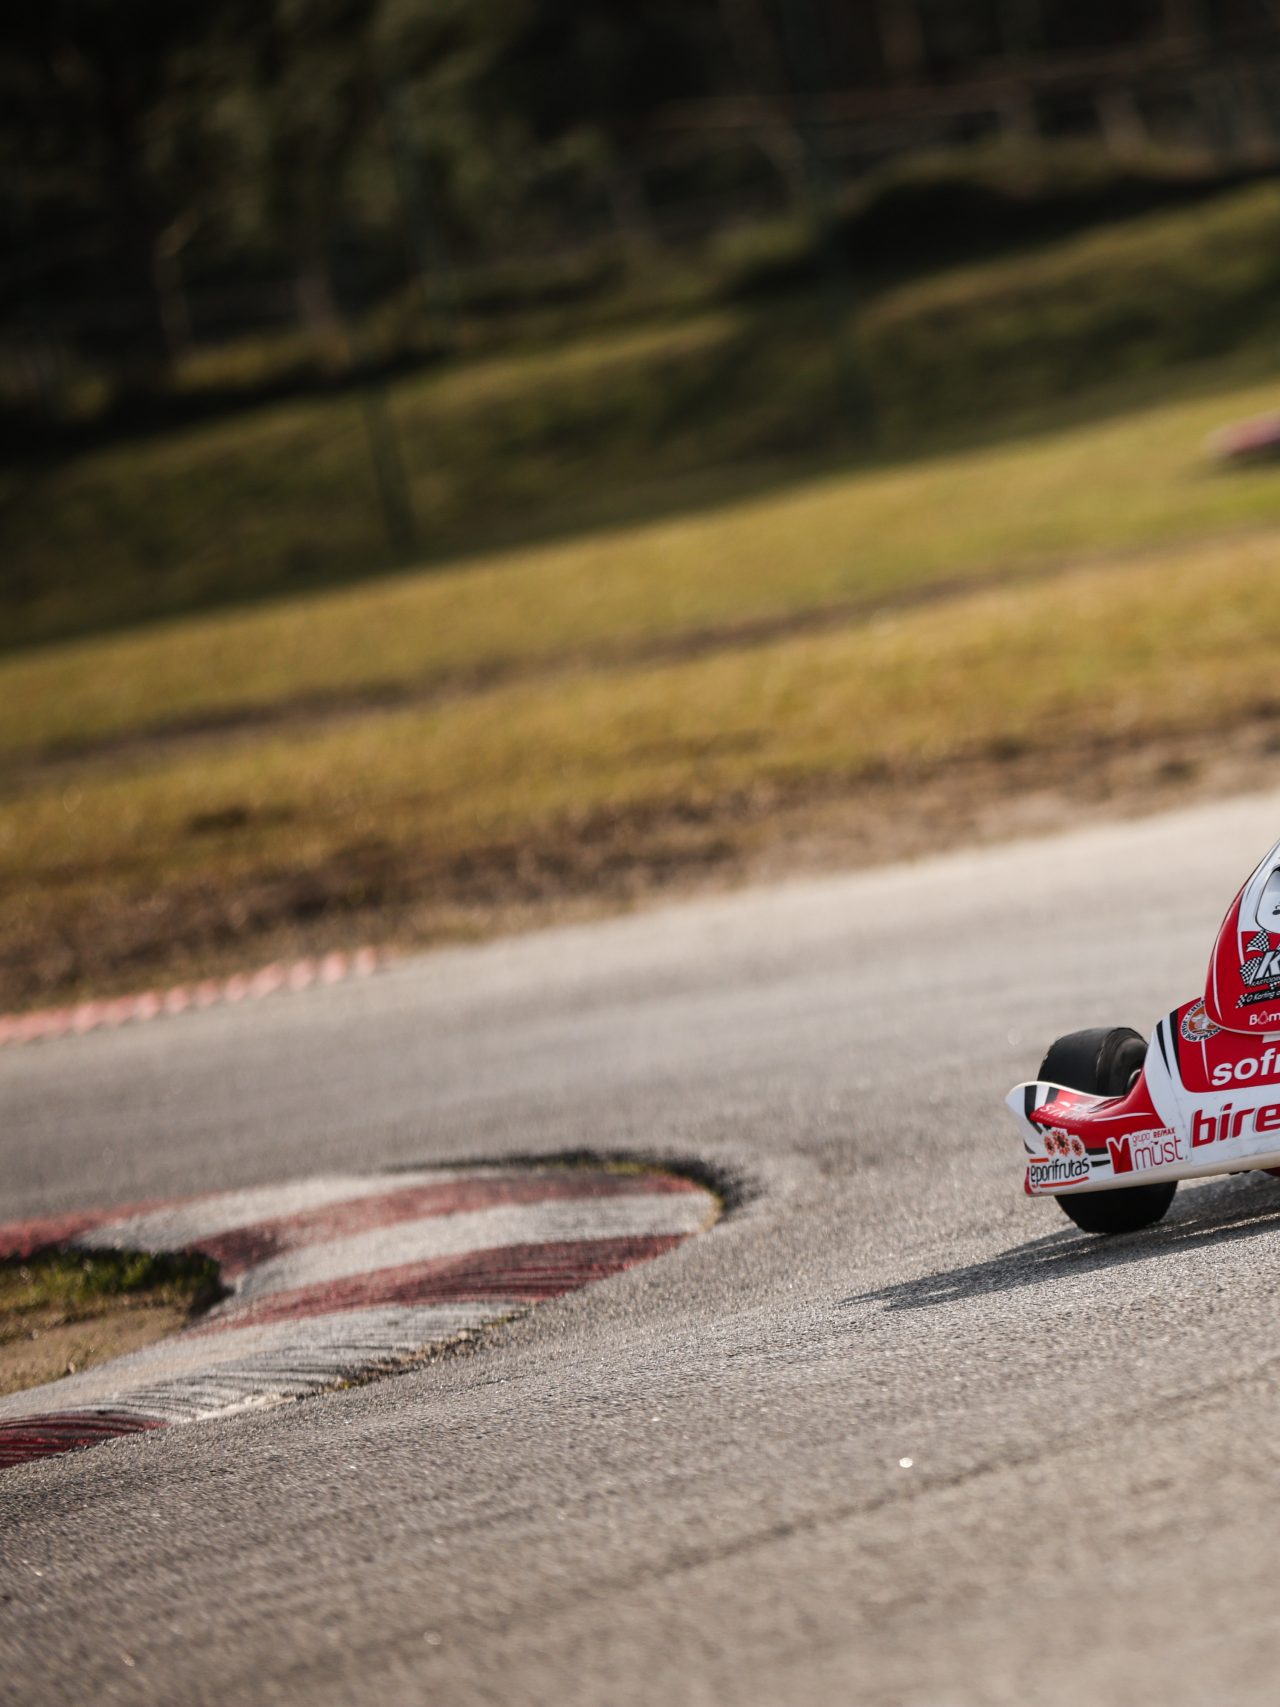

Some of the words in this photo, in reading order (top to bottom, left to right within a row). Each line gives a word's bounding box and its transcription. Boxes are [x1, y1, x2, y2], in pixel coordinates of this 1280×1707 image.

[1246, 995, 1254, 1003] O
[1254, 991, 1275, 1000] Karting
[1132, 1132, 1151, 1147] grupo
[1153, 1127, 1176, 1139] RE/MAX
[1030, 1157, 1091, 1186] eporifrutas
